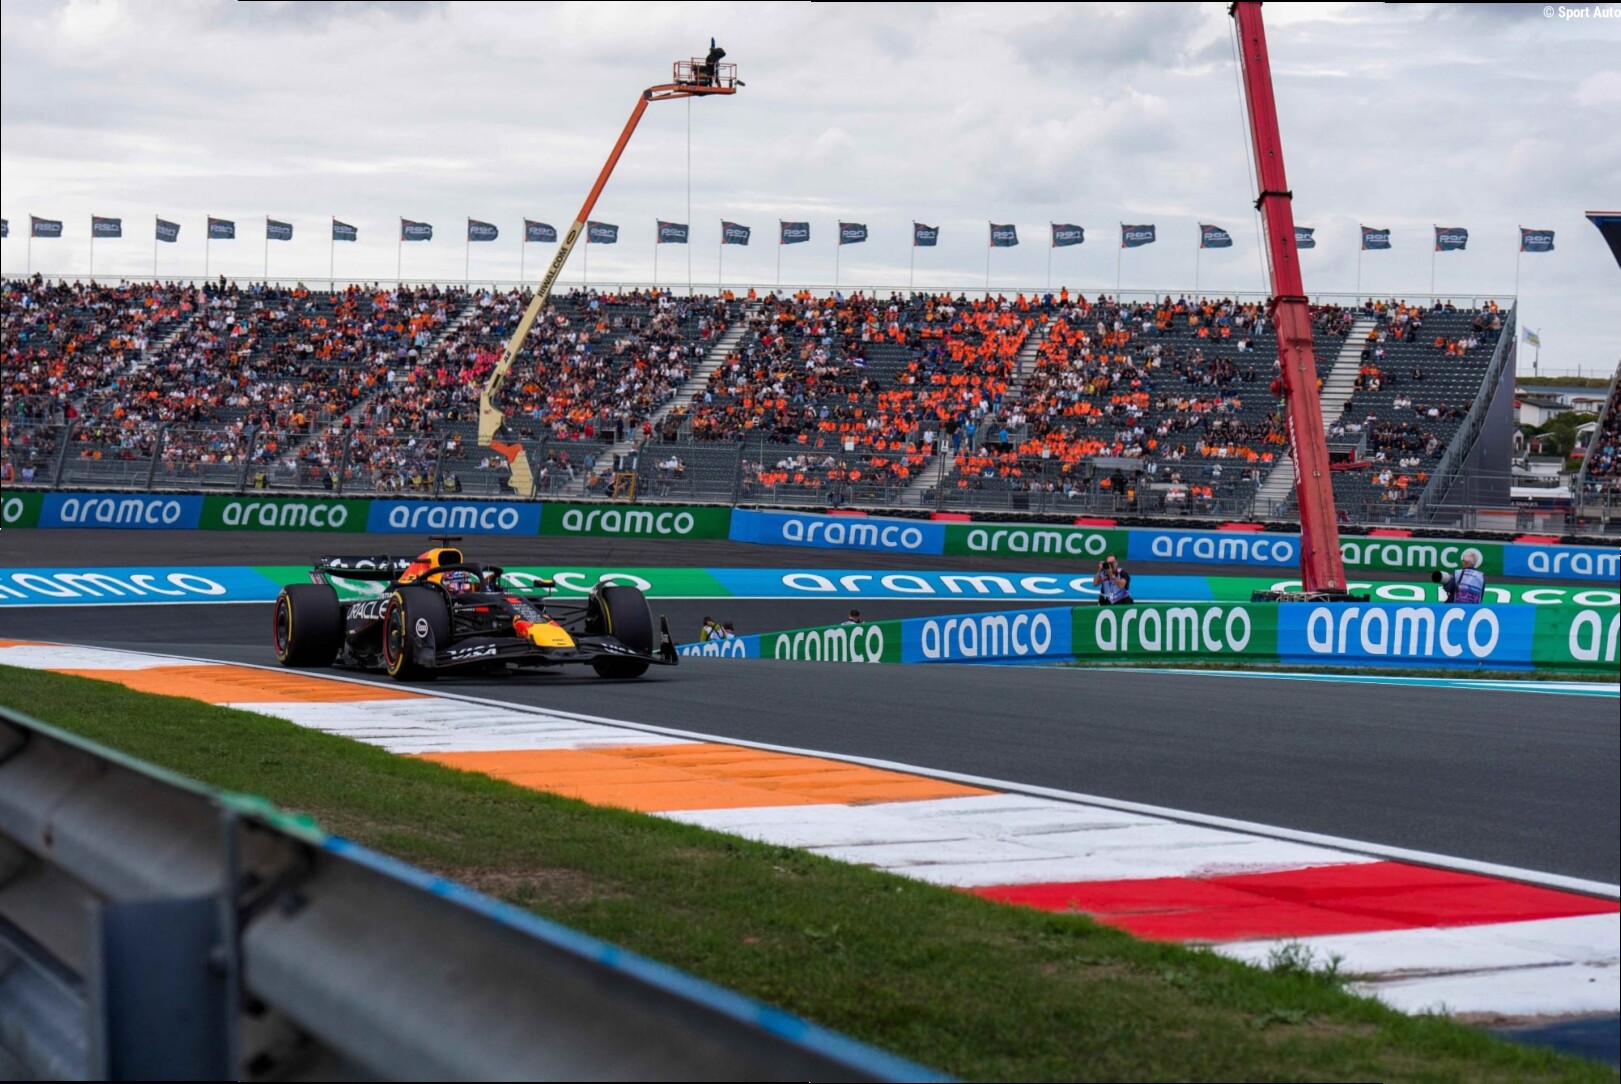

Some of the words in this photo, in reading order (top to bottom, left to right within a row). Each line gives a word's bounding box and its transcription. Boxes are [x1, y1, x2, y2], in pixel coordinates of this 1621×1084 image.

[60, 498, 182, 525] aramco
[222, 503, 348, 527] aramco
[388, 506, 519, 529] aramco
[562, 509, 694, 534] aramco
[782, 519, 922, 549] aramco
[967, 529, 1107, 556] aramco
[1151, 536, 1293, 562] aramco
[1340, 543, 1483, 569] aramco
[921, 612, 1052, 659] aramco
[1095, 606, 1251, 652] aramco
[1307, 607, 1500, 658] aramco
